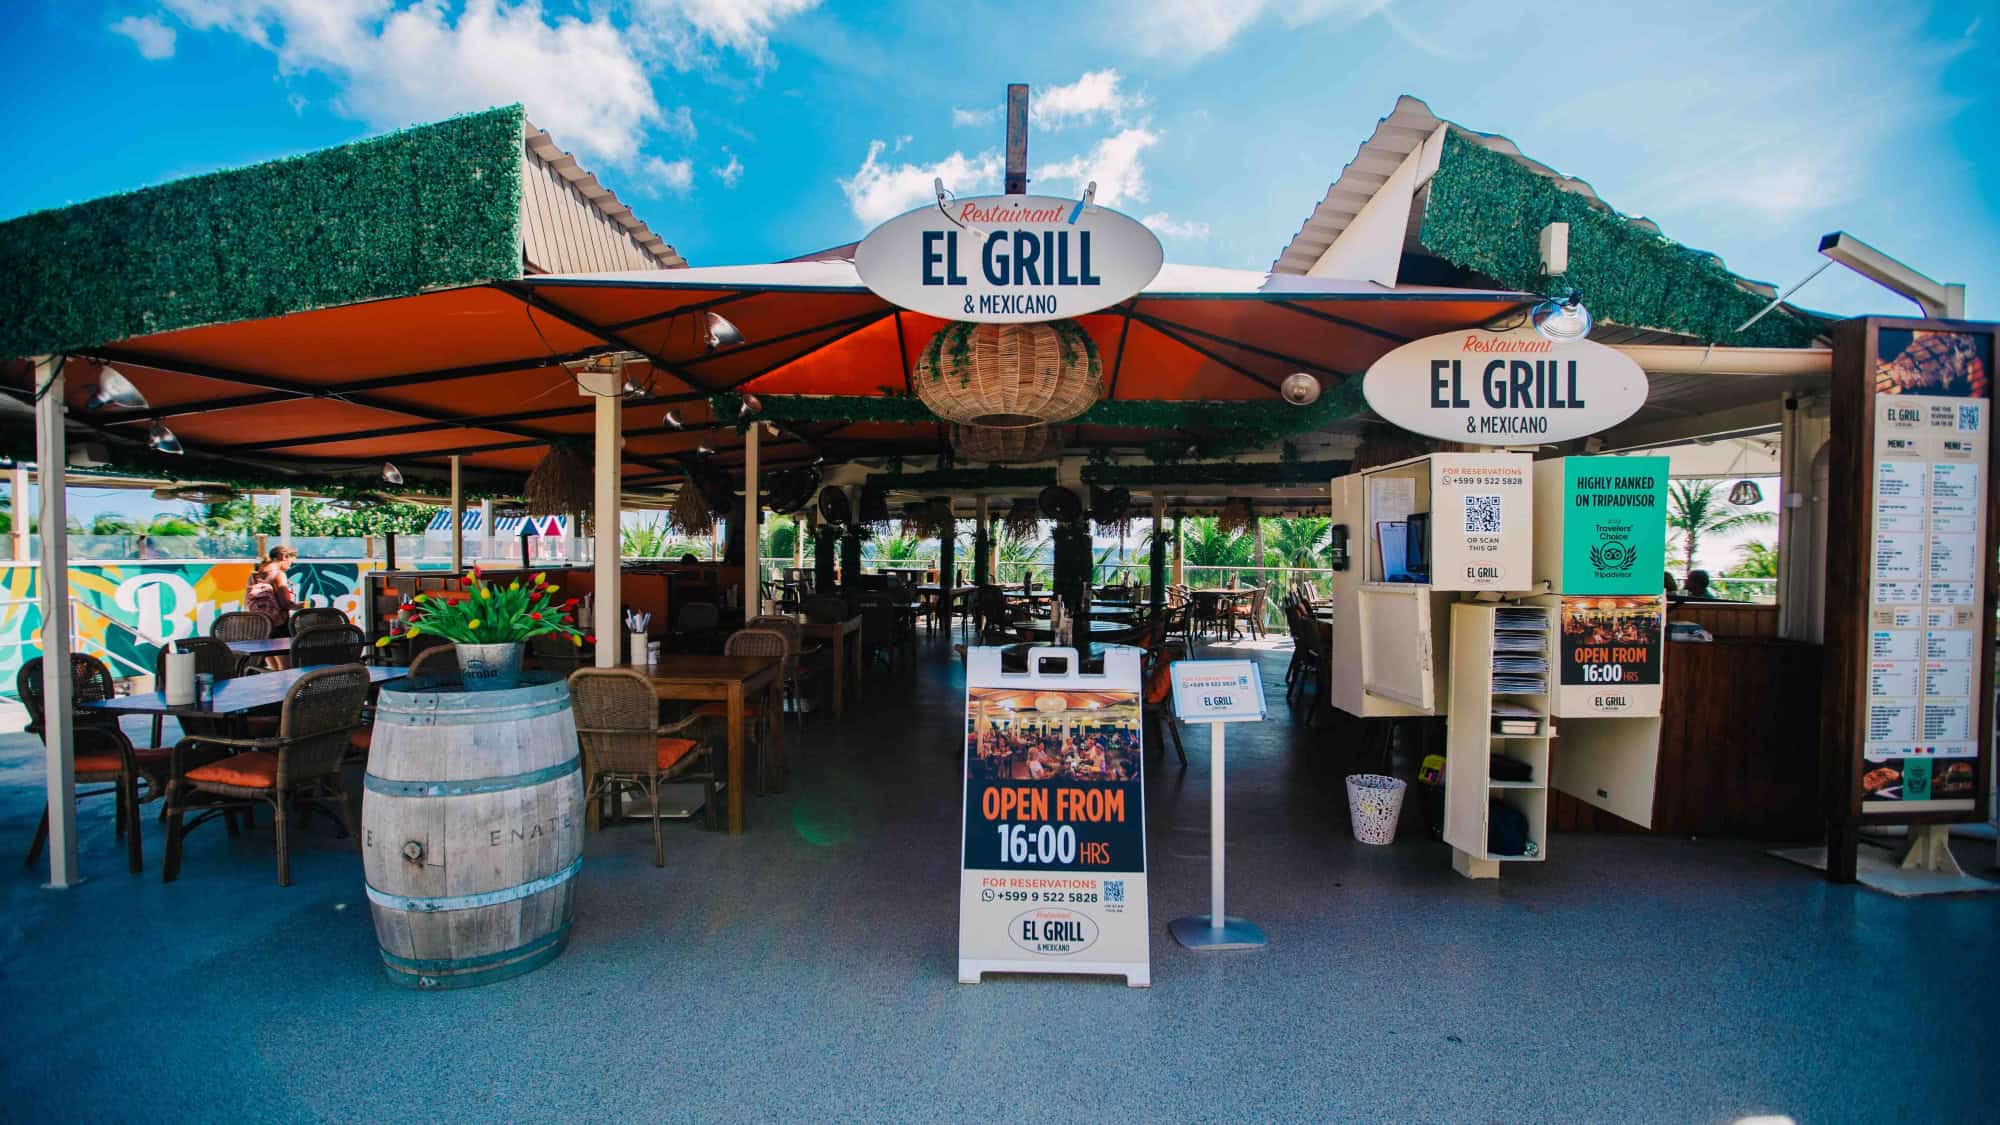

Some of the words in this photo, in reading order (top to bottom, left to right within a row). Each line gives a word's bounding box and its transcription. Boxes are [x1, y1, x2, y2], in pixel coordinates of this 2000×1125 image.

[960, 203, 1064, 224] Restaurant
[922, 231, 967, 285] EL
[982, 230, 1100, 286] GRILL
[964, 297, 975, 313] &
[980, 295, 1057, 314] MEXICANO
[1462, 335, 1552, 352] Restaurant
[1431, 360, 1469, 408] EL
[1483, 360, 1584, 409] GRILL
[1888, 409, 1896, 421] EL
[1899, 409, 1920, 421] GRILL
[1467, 417, 1477, 433] &
[1480, 417, 1547, 433] MEXICANO
[1577, 477, 1612, 489] HIGHLY
[1615, 477, 1654, 489] RANKED
[1576, 495, 1589, 506] ON
[1593, 495, 1655, 507] TRIPADVISOR
[1467, 568, 1475, 577] EL
[1478, 568, 1498, 577] GRILL
[1575, 648, 1608, 663] OPEN
[1613, 648, 1647, 663] FROM
[1583, 664, 1622, 681] 16:00
[1624, 672, 1639, 681] HRS
[1204, 697, 1212, 705] EL
[1214, 696, 1232, 705] GRILL
[1595, 697, 1603, 705] EL
[1606, 697, 1626, 705] GRILL
[983, 787, 1048, 821] OPEN
[1057, 788, 1125, 822] FROM
[998, 824, 1076, 864] 16:00
[1080, 843, 1110, 864] HRS
[982, 878, 1007, 887] FOR
[1010, 879, 1096, 889] RESERVATIONS
[998, 891, 1027, 901] +599
[1032, 892, 1039, 901] 9
[1043, 892, 1064, 902] 522
[1069, 893, 1098, 903] 5828
[1024, 921, 1039, 940] EL
[1044, 921, 1084, 941] GRILL
